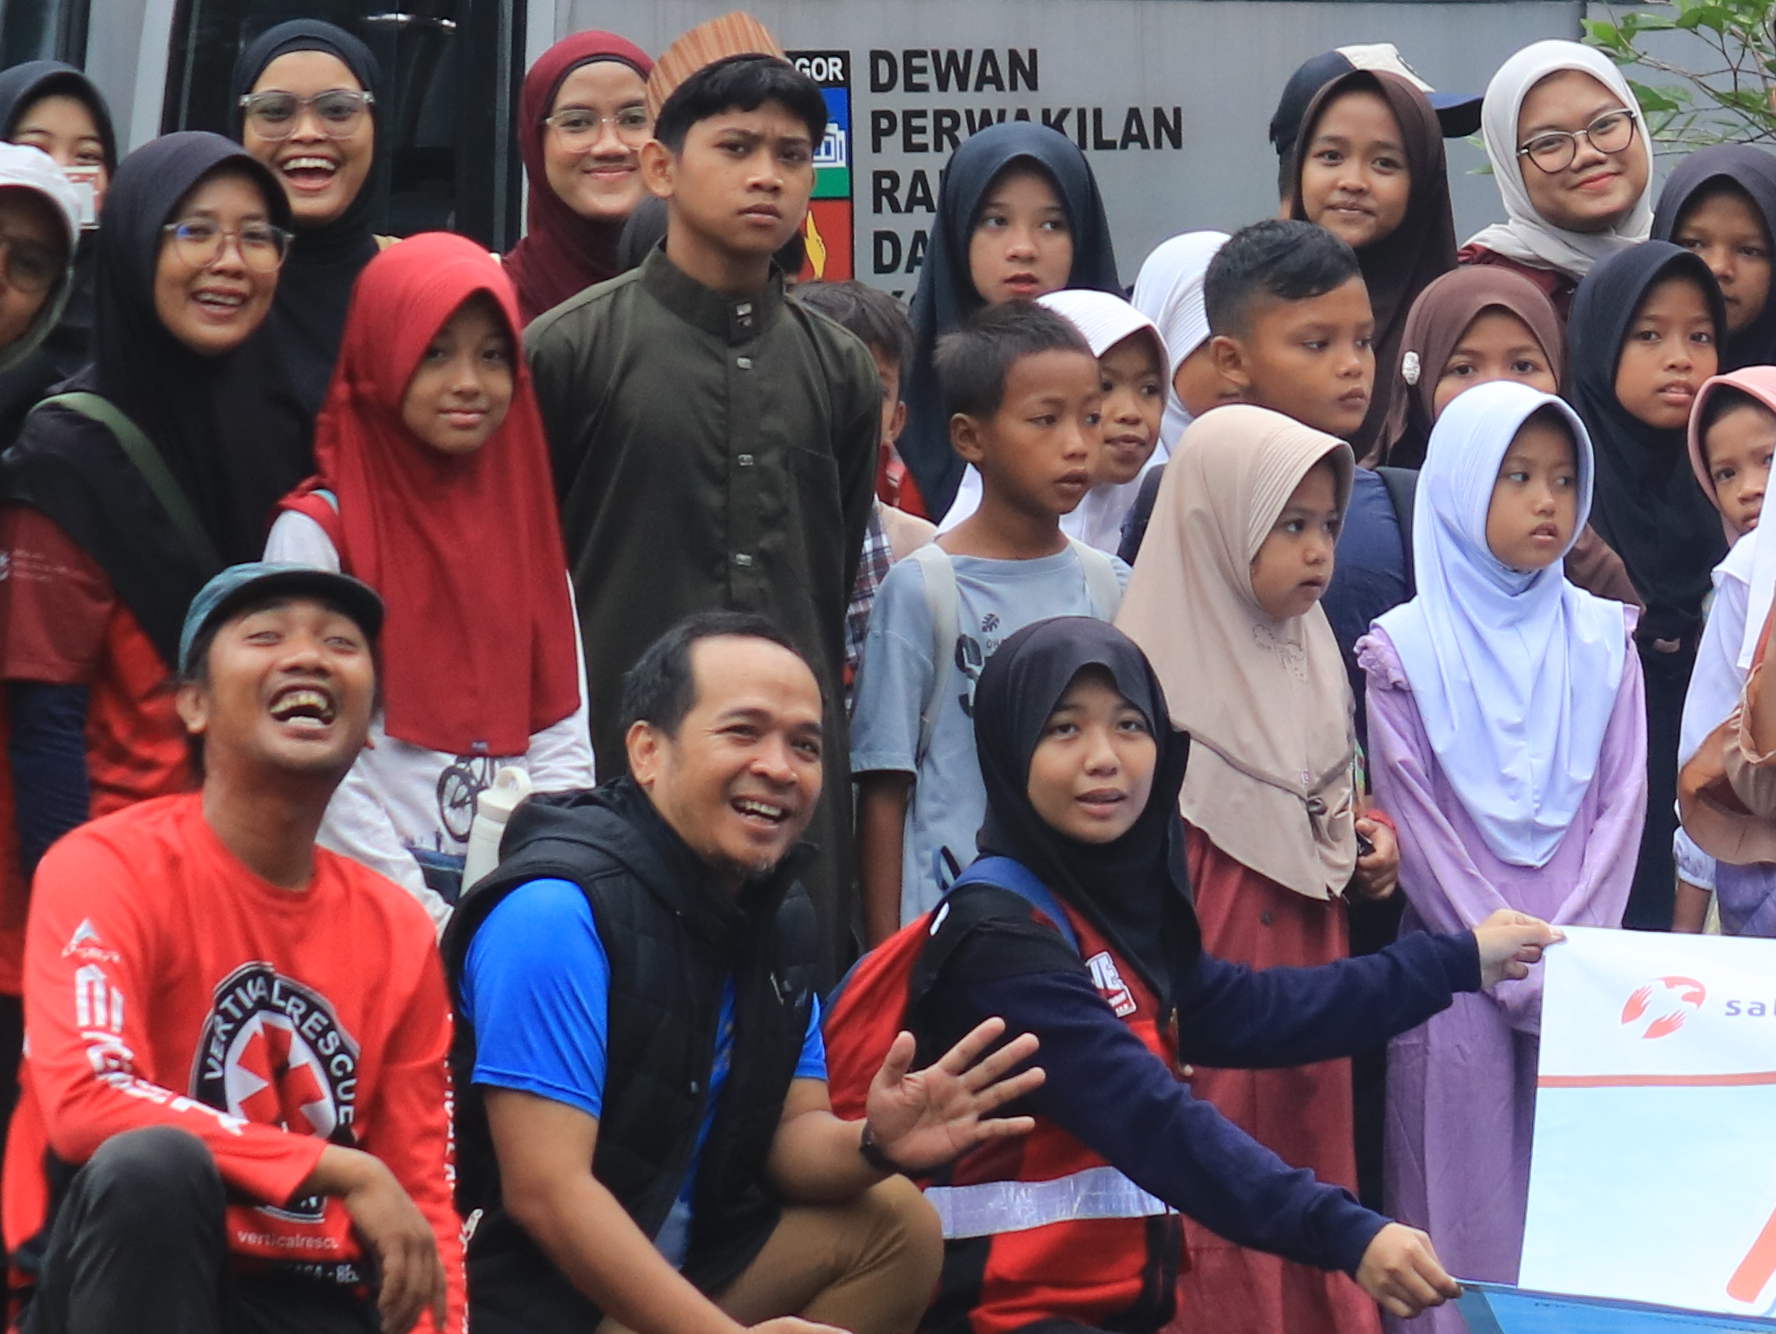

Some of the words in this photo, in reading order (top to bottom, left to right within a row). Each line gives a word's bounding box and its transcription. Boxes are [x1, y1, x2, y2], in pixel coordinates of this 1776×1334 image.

[794, 56, 845, 82] GOR
[869, 48, 1038, 93] DEWAN
[871, 106, 1183, 153] PERKILAN
[285, 998, 358, 1125] RESCUE
